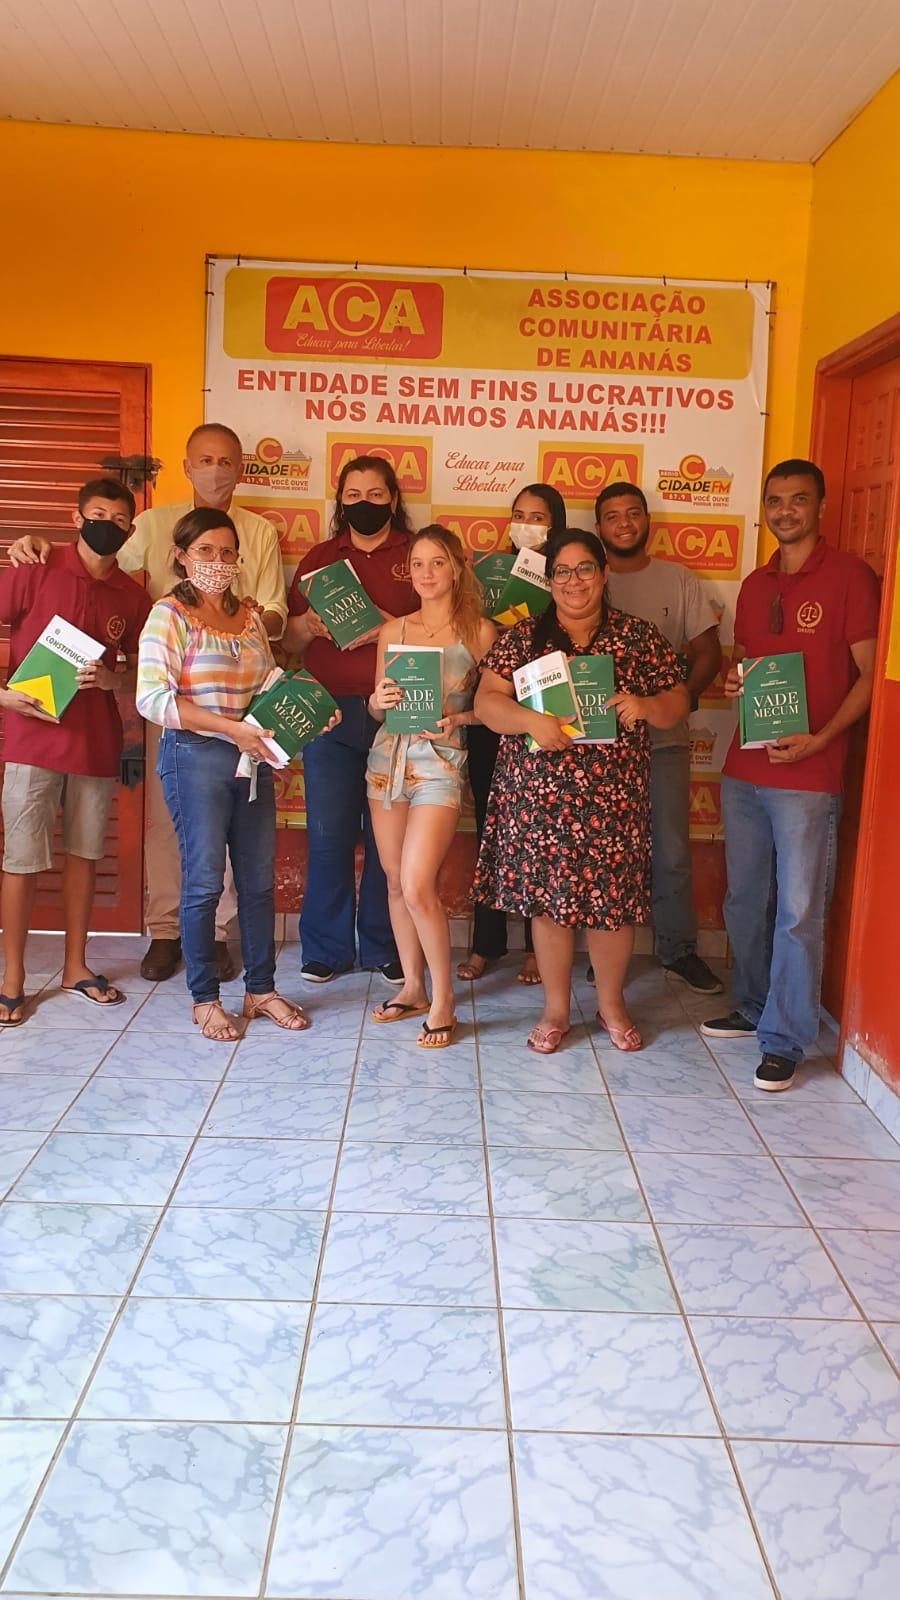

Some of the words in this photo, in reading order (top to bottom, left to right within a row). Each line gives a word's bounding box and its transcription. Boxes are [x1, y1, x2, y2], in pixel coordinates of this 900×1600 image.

[282, 281, 426, 337] ACA
[528, 288, 706, 318] ASSOCIAÇÃO
[296, 333, 330, 348] Educar
[328, 340, 359, 352] para
[519, 317, 713, 345] COMUNITÁRIA
[537, 347, 571, 368] DE
[579, 348, 692, 373] ANANÁS
[237, 368, 388, 396] ENTIDADE
[398, 375, 460, 399] SEM
[470, 379, 538, 402] FINS
[548, 382, 735, 411] LUCRATIVOS
[305, 395, 367, 422] NÓS
[376, 402, 507, 428] AMAMOS
[515, 407, 667, 434] ANANÁS!!!
[244, 462, 289, 476] IDADE
[444, 451, 490, 471] Educar
[486, 460, 526, 476] para
[547, 456, 631, 489] ACA
[452, 474, 517, 493] Libertar!
[658, 480, 711, 493] CIDADE
[711, 480, 731, 494] FM
[693, 494, 711, 502] VOCÊ
[647, 526, 734, 559] ACA
[324, 591, 363, 617] VADE
[330, 600, 367, 626] MECUM
[403, 689, 435, 702] ADE
[752, 691, 799, 708] VADE
[273, 701, 307, 738] MECUM
[281, 695, 314, 734] VADE
[581, 706, 608, 717] CUM
[754, 704, 799, 719] MECUM
